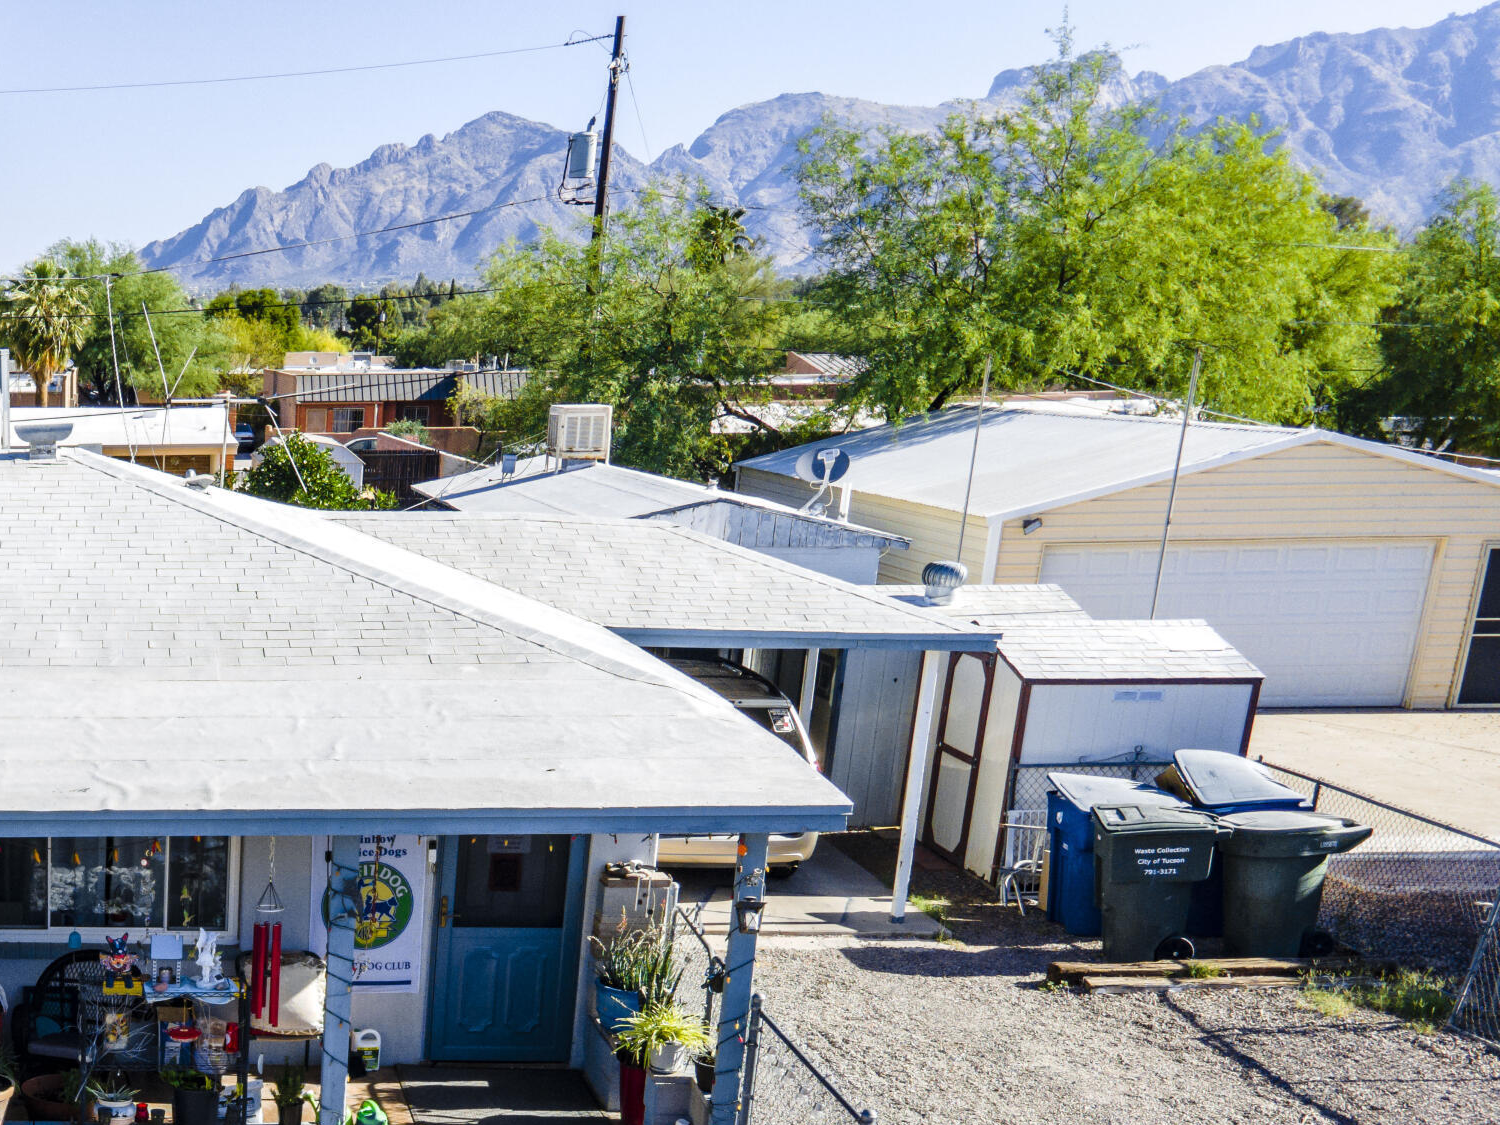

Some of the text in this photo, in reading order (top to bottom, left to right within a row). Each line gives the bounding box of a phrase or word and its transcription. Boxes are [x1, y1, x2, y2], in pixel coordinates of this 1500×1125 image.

[379, 848, 408, 858] Dogs
[379, 867, 408, 898] DOG
[384, 961, 411, 971] CLUB
